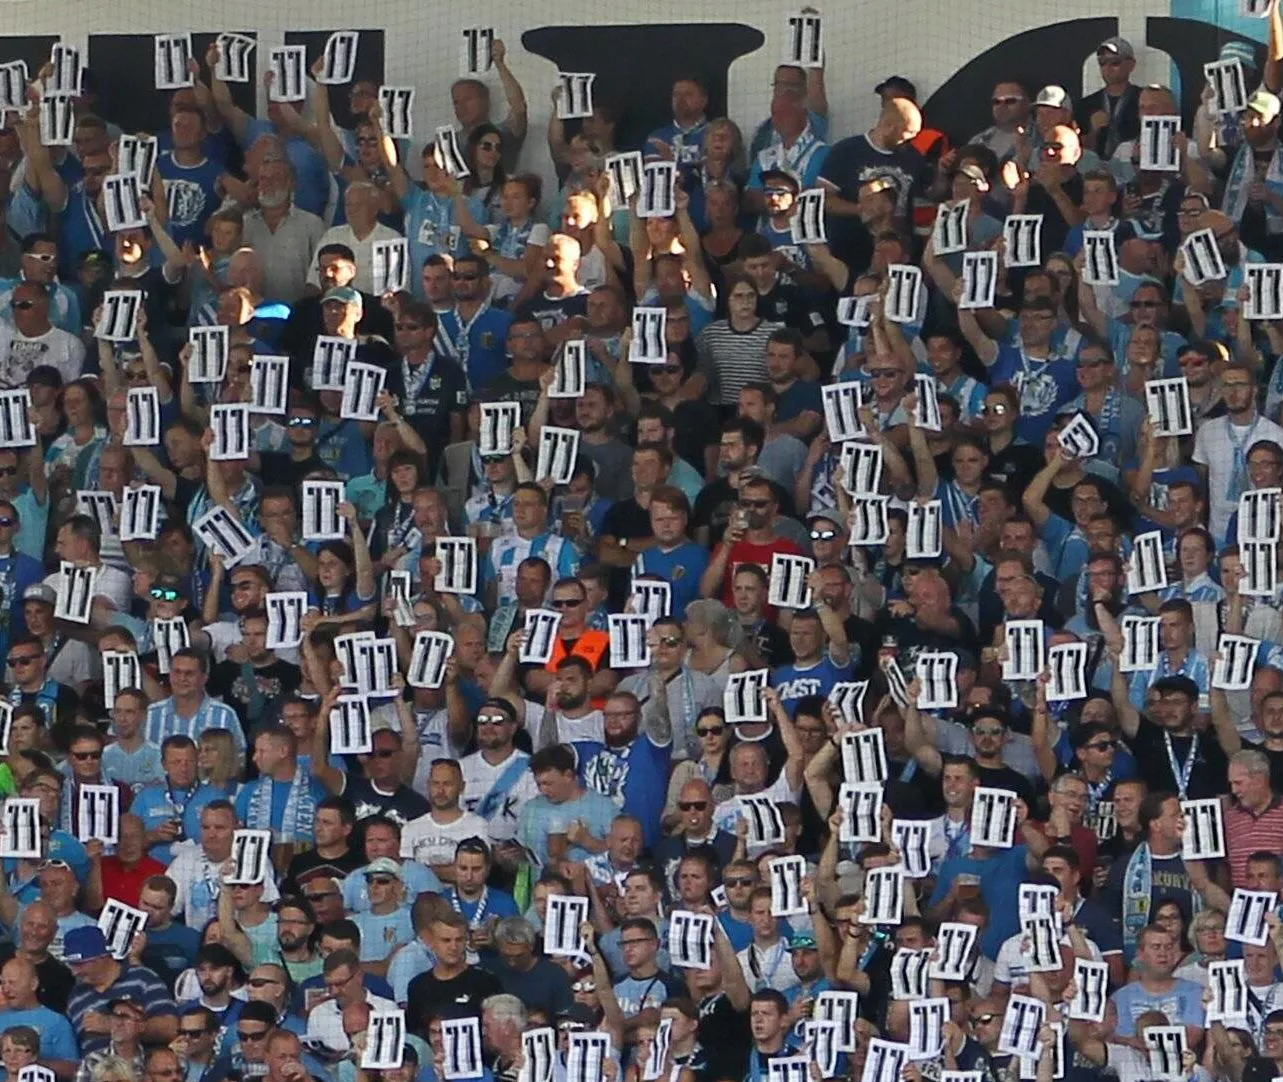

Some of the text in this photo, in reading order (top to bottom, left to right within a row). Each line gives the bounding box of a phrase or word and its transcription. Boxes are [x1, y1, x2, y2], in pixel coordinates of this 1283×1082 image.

[789, 18, 821, 62] 11
[272, 50, 301, 96] 11
[1207, 63, 1243, 110] 11
[382, 89, 412, 135] 11
[107, 176, 142, 223] 11
[890, 270, 918, 318] 11
[966, 257, 994, 302] 11
[1248, 268, 1281, 315] 11
[104, 296, 137, 338] 11
[635, 313, 663, 358] 11
[484, 407, 520, 452] 11
[1150, 382, 1188, 431] 11
[214, 408, 244, 454] 11
[127, 490, 156, 534] 11
[307, 487, 341, 533] 11
[440, 542, 473, 589] 11
[1243, 542, 1272, 591] 11
[1008, 627, 1039, 674] 11
[921, 658, 952, 702] 11
[8, 805, 36, 851] 11
[83, 791, 113, 838] 11
[846, 790, 878, 837] 11
[979, 794, 1016, 842] 11
[939, 929, 971, 973] 11
[1212, 966, 1242, 1013] 11
[445, 1024, 477, 1073] 11
